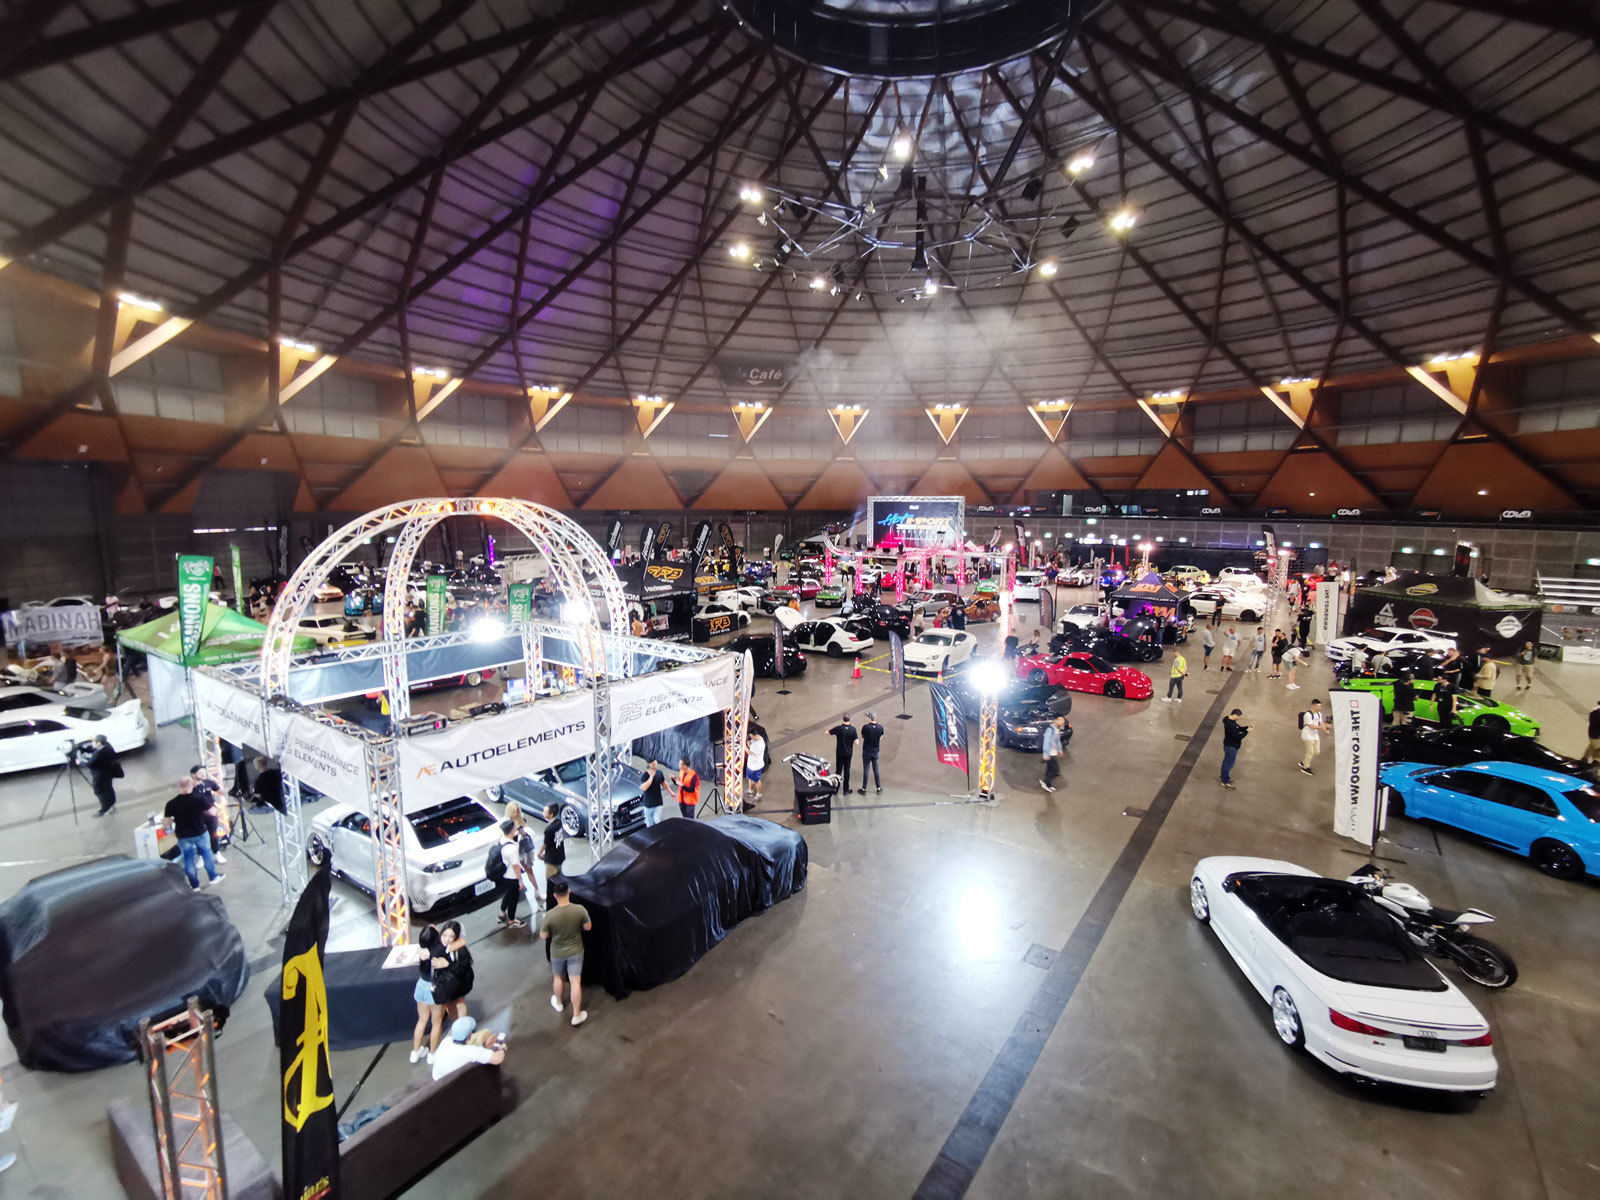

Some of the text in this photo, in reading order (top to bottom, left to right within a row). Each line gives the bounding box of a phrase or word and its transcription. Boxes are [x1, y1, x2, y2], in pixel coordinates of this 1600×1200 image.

[749, 368, 782, 380] Café
[906, 517, 953, 525] IMPORT
[440, 720, 587, 773] AUTOELEMENTS
[293, 749, 338, 777] ELEMENTS
